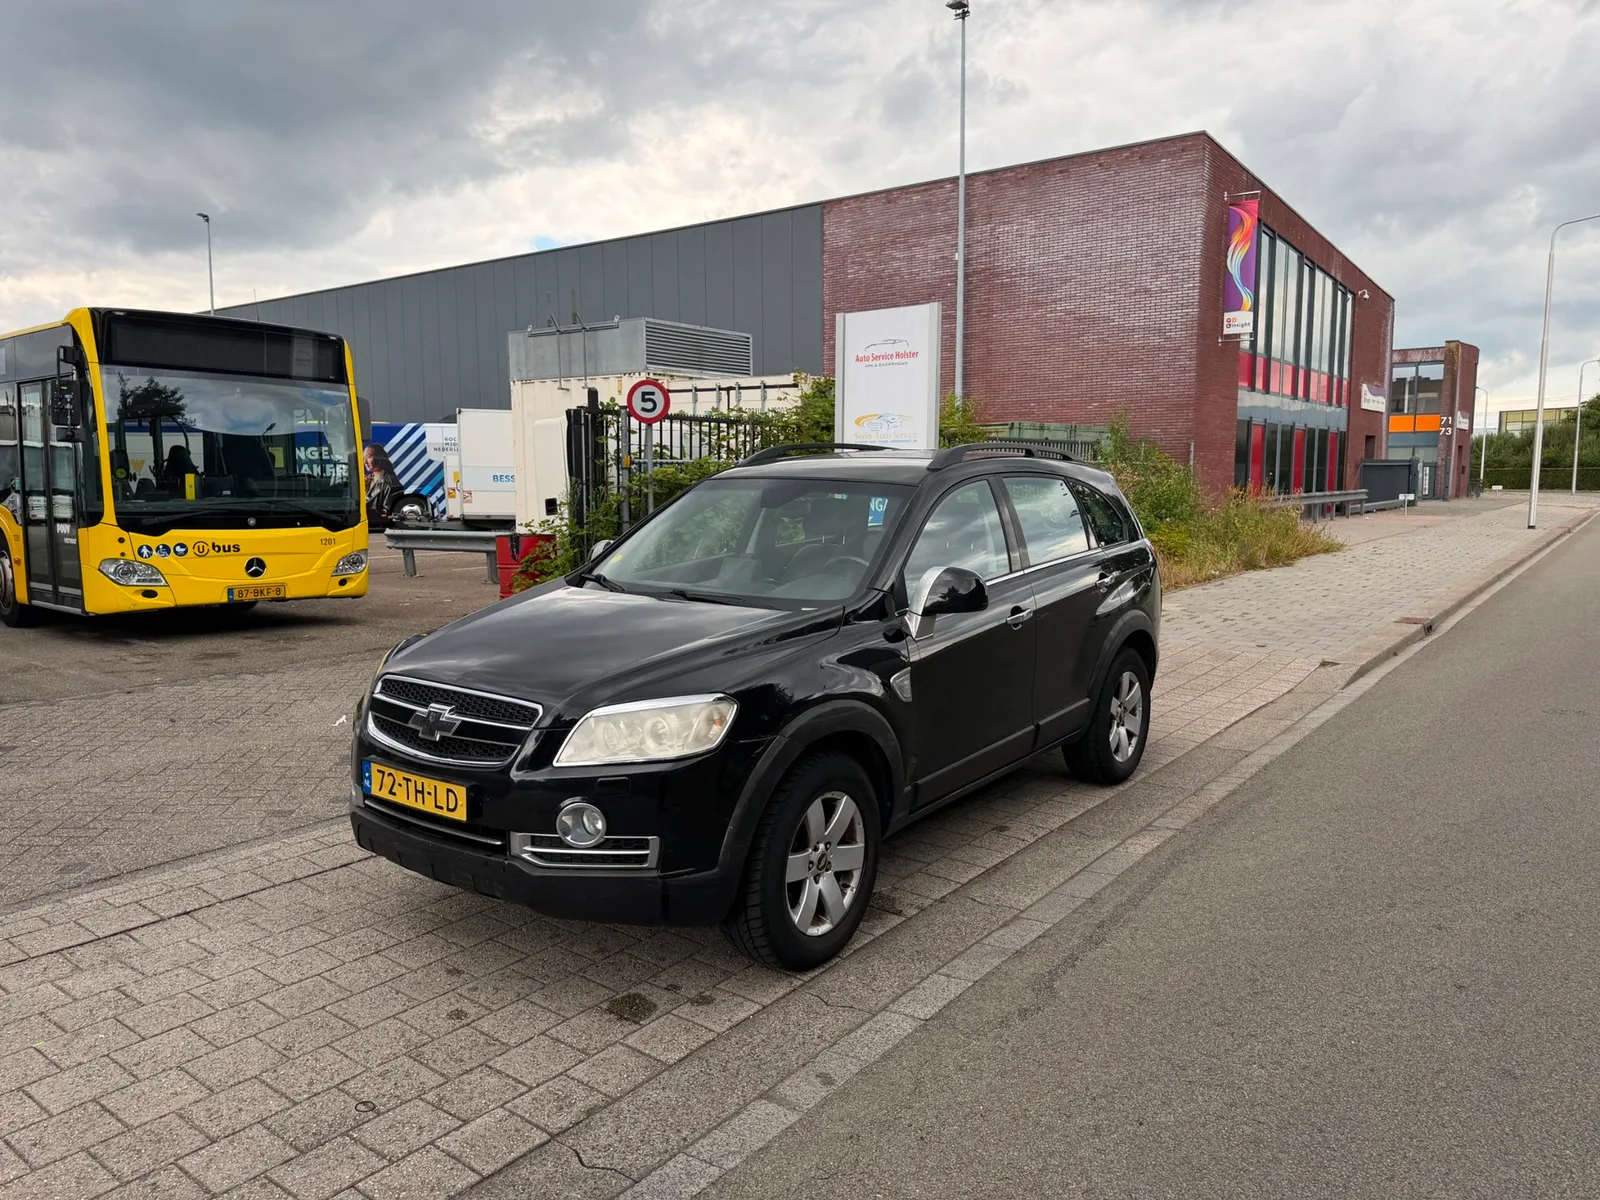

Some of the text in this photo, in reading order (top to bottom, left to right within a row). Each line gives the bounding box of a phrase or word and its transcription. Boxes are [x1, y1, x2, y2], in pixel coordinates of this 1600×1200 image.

[855, 350, 919, 363] Auto Service Holster
[640, 391, 658, 413] 5
[1440, 416, 1452, 425] 71
[1439, 427, 1452, 436] 73
[211, 541, 241, 553] bus
[320, 538, 336, 546] 1201
[237, 587, 282, 598] 87-BKF-8
[376, 768, 459, 813] 72-TH-LD
